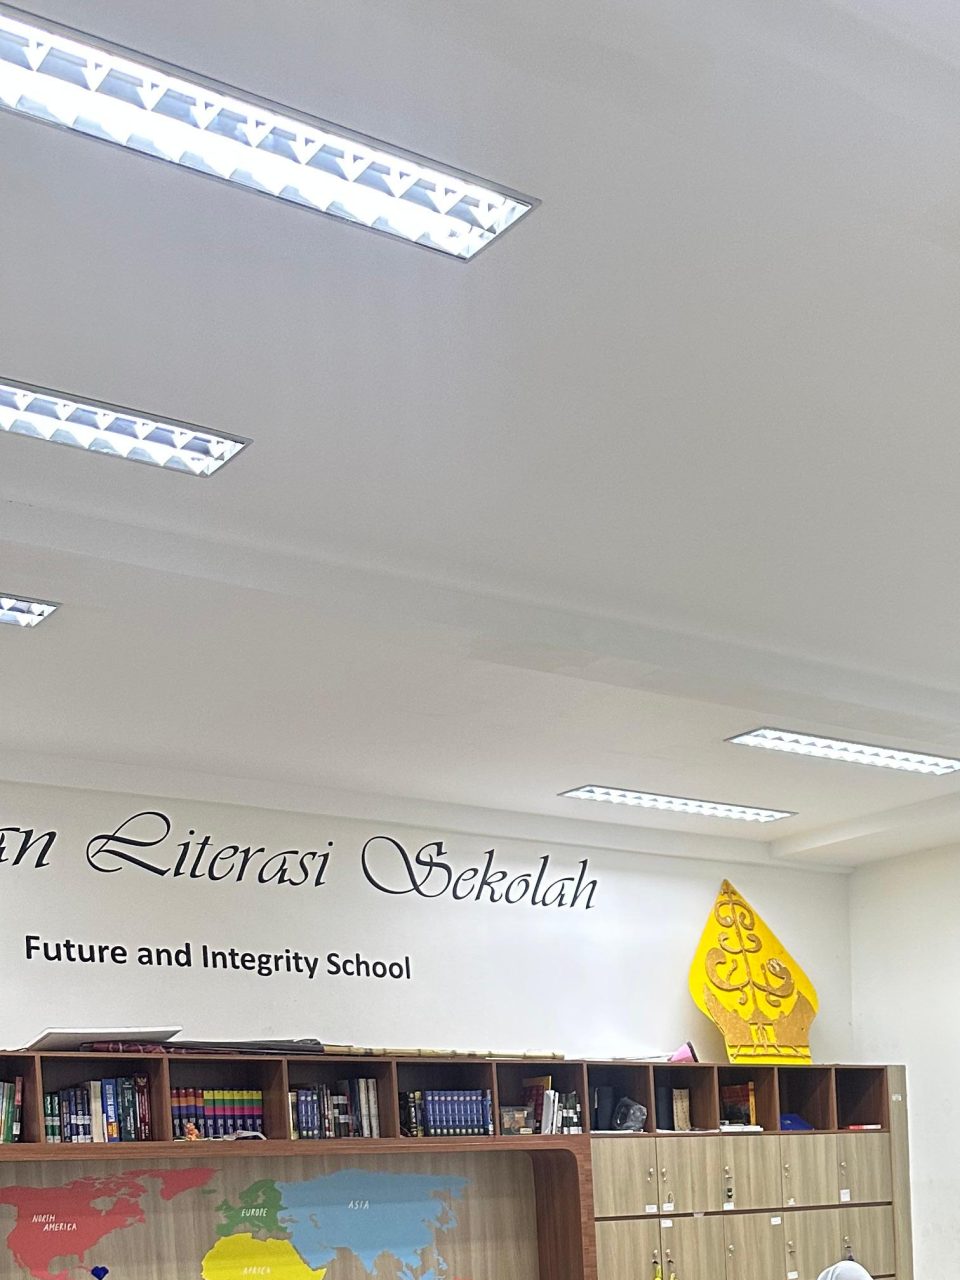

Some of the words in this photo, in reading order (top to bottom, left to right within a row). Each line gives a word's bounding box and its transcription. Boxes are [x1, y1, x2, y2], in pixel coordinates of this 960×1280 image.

[86, 811, 334, 888] Literasi
[361, 835, 598, 910] Sekolah
[25, 935, 128, 965] Future
[137, 942, 192, 968] and
[202, 945, 319, 980] Integrity
[326, 952, 411, 980] School
[348, 1200, 370, 1210] ASIA
[241, 1207, 268, 1217] EUROPE
[32, 1214, 56, 1223] NORTH
[43, 1222, 77, 1232] AMERICA
